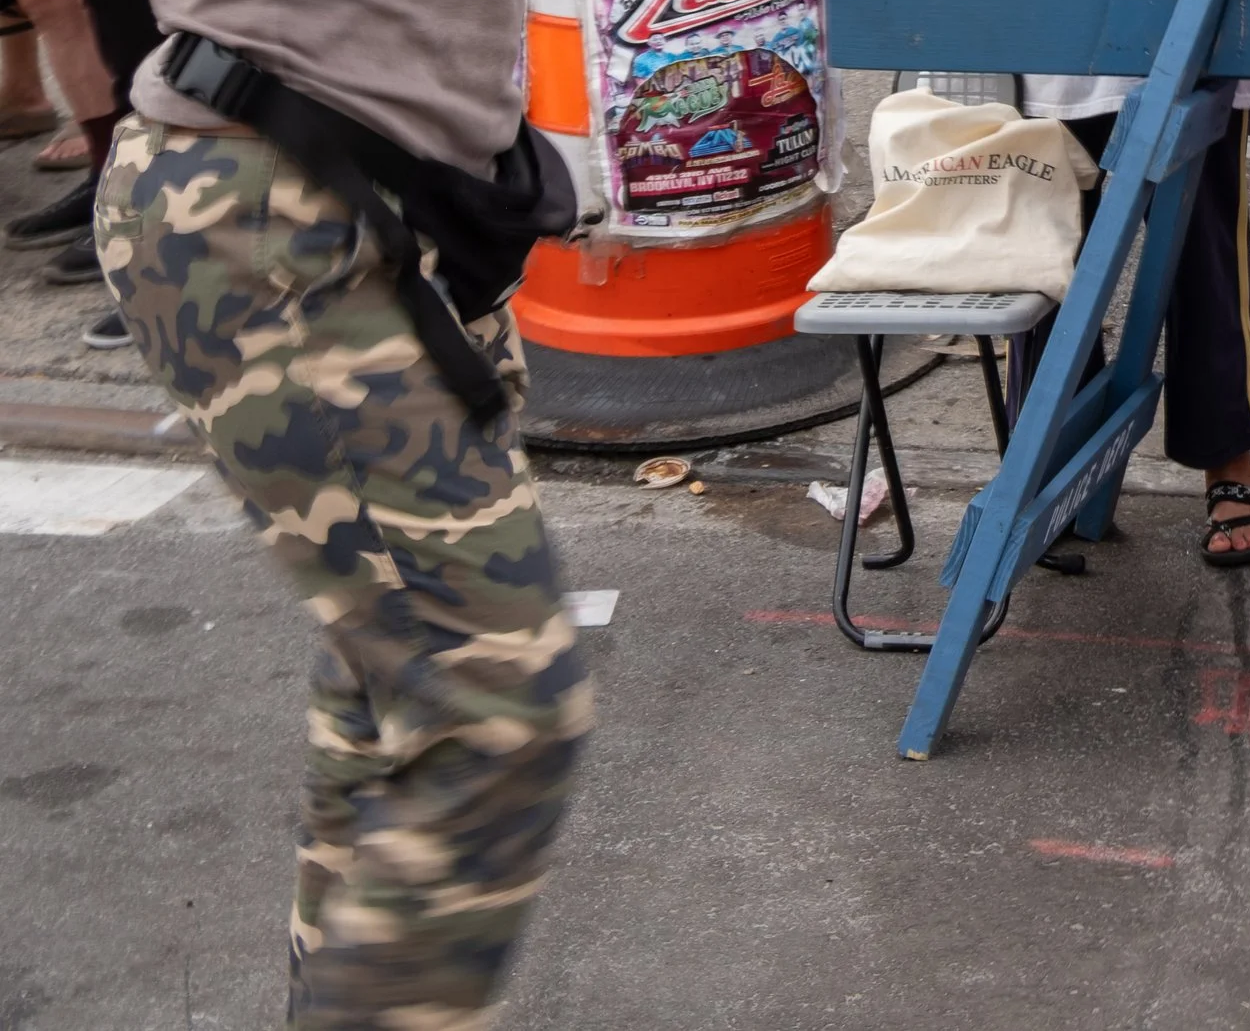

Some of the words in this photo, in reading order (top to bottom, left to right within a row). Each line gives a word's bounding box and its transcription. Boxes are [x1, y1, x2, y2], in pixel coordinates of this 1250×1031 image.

[717, 167, 748, 183] 11232
[882, 155, 984, 183] AMERICAN
[988, 153, 1056, 182] EAGLE
[924, 174, 1000, 187] OUTFITTERS
[1043, 461, 1098, 545] POLICE
